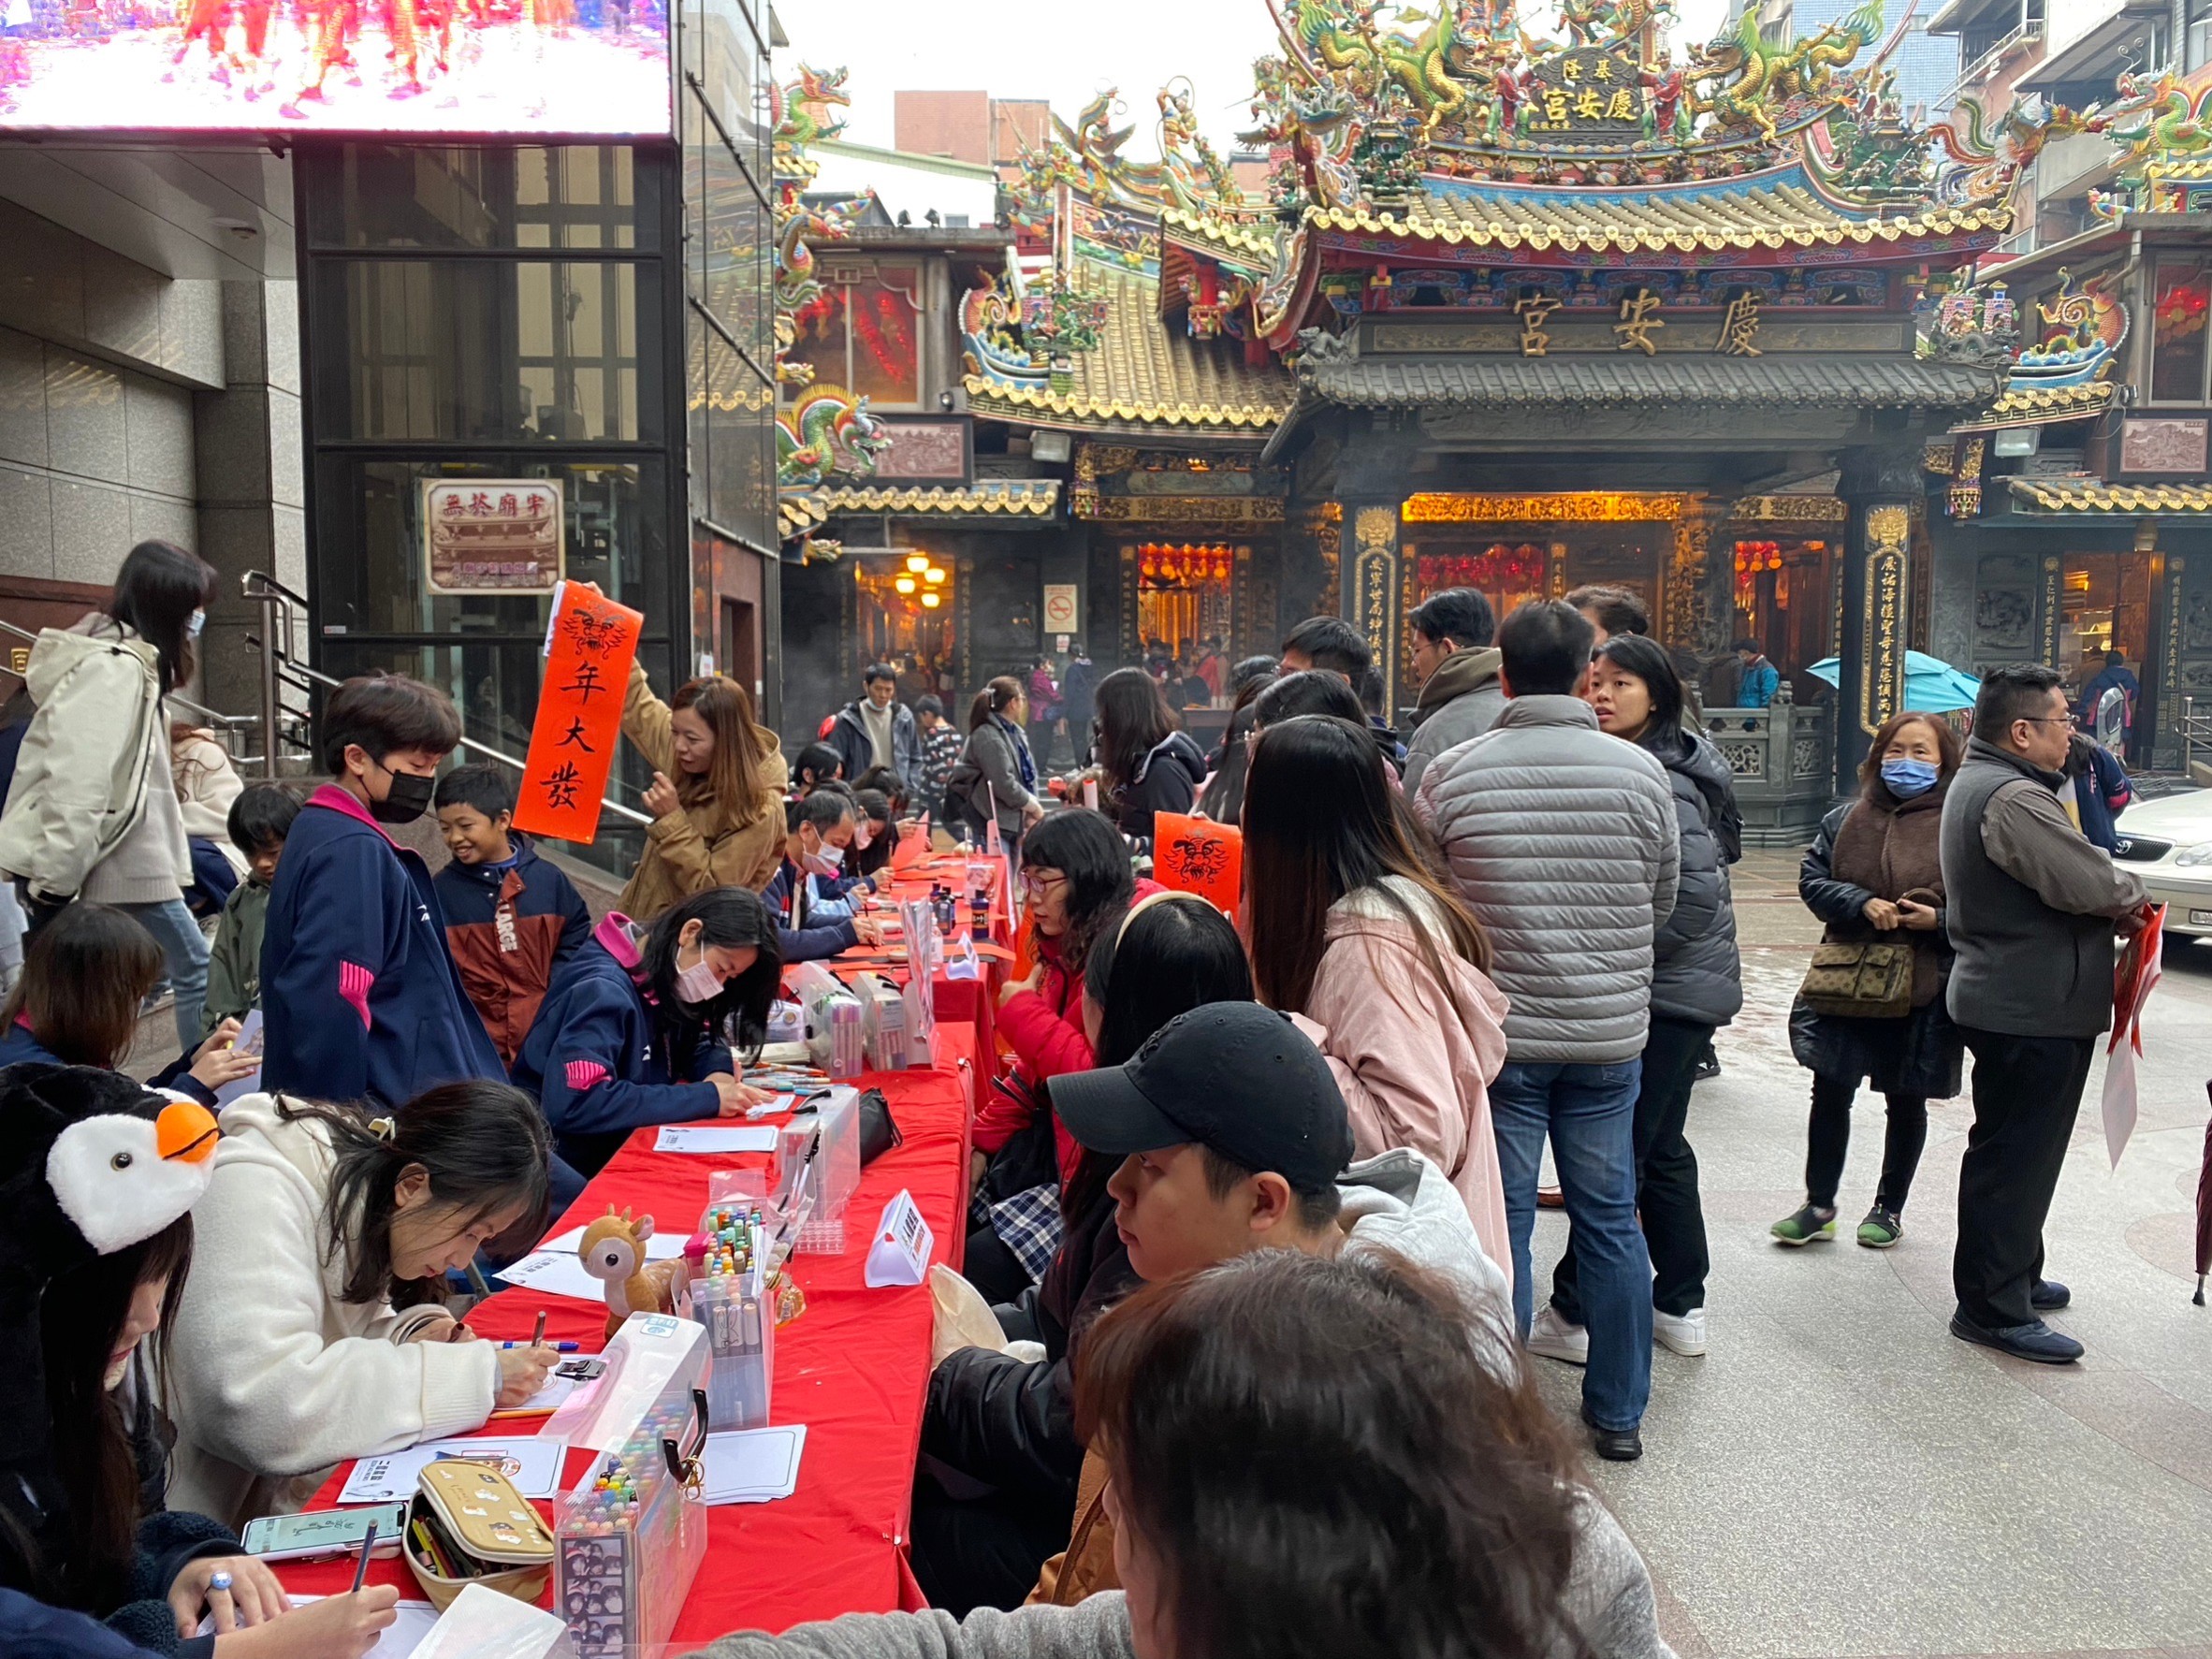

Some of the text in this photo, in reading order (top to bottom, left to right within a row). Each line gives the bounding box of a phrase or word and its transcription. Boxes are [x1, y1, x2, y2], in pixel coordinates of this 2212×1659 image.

[1563, 58, 1613, 80] 基隆
[1541, 87, 1638, 121] 慶安宮
[1512, 288, 1763, 358] 慶安宮
[443, 492, 546, 517] 無菸廟宇
[495, 899, 518, 953] LARGE
